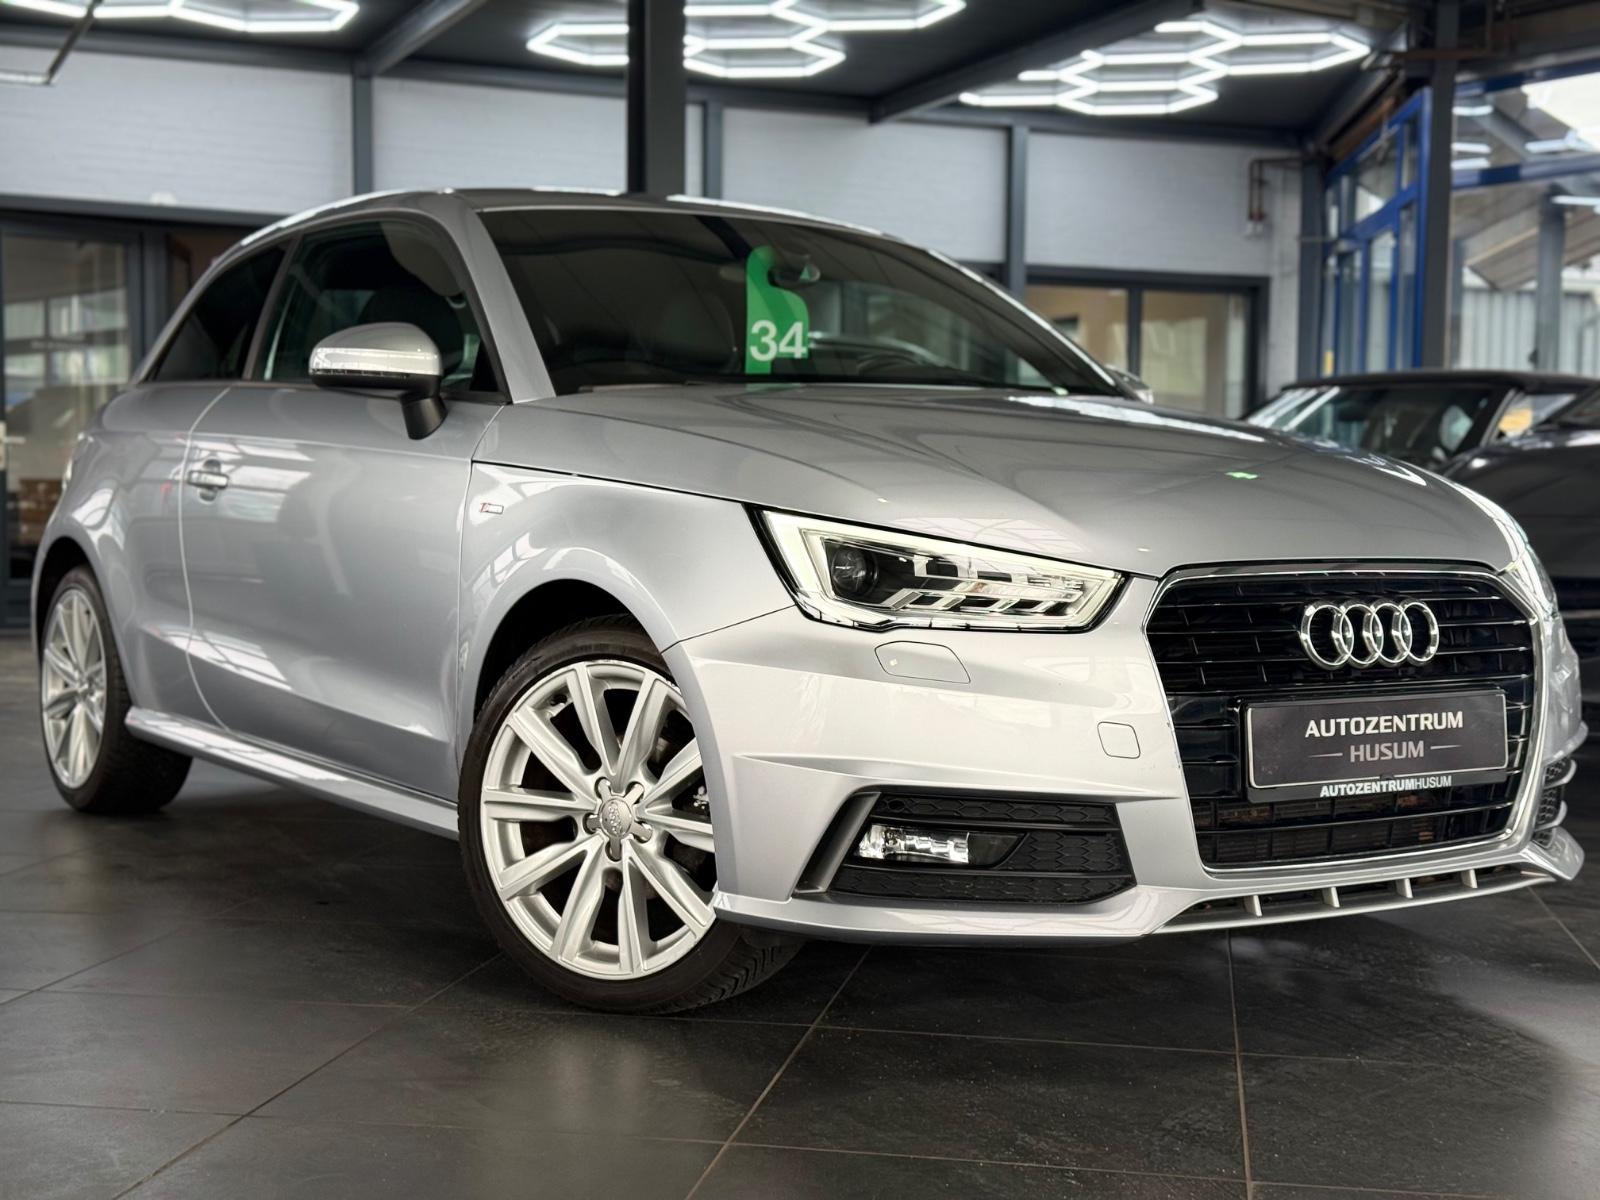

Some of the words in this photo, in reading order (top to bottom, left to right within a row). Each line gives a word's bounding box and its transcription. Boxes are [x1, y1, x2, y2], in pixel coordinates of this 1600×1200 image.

[750, 319, 808, 361] 34
[1304, 711, 1464, 738] AUTOZENTRUM
[1350, 740, 1424, 763] HUSUM
